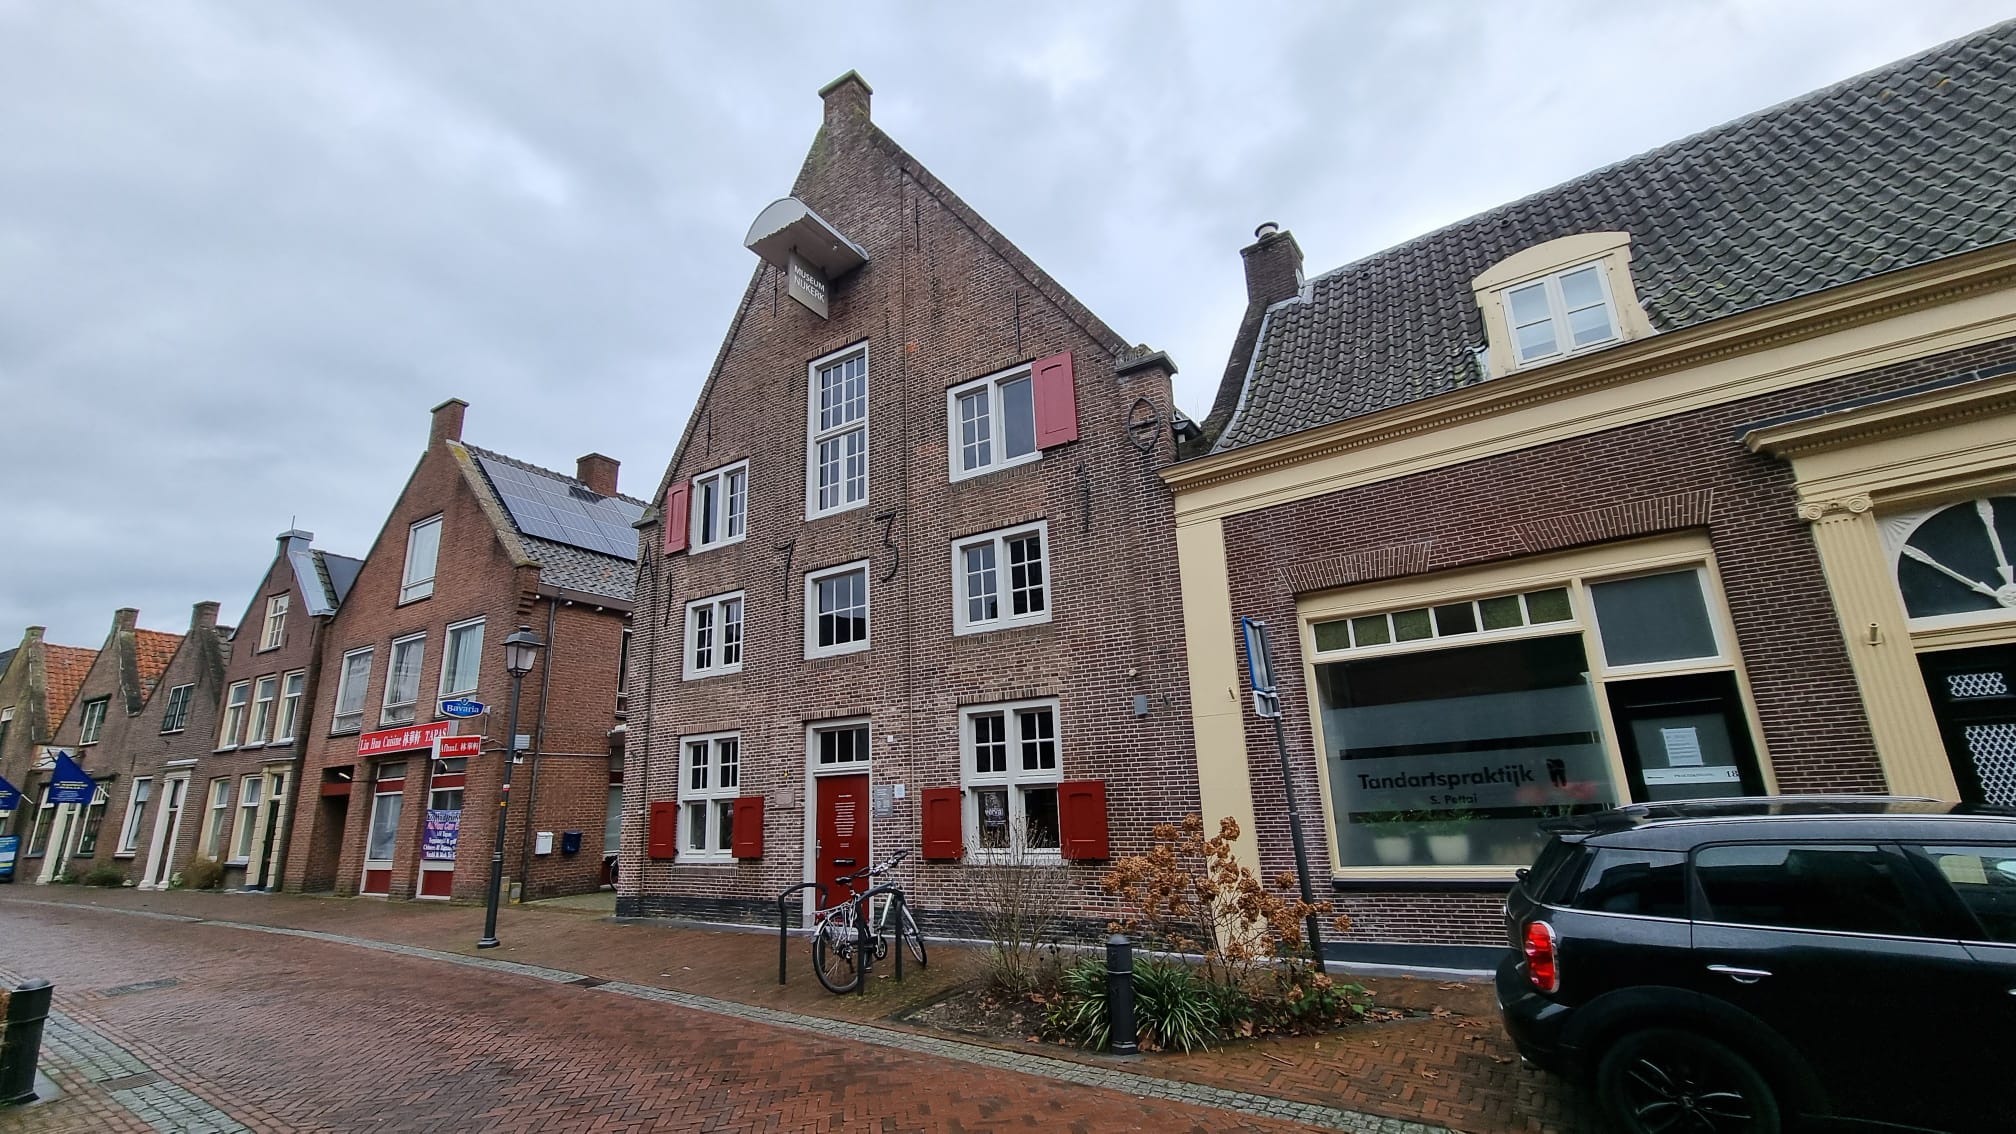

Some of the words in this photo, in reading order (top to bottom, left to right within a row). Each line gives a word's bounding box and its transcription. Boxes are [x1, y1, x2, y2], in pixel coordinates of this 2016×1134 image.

[794, 264, 825, 293] MUSEUM
[447, 704, 479, 713] Bavaria
[382, 735, 402, 748] Cuisine
[424, 728, 448, 743] TAPAS
[1358, 764, 1535, 791] Tandartspraktijk
[1726, 770, 1739, 778] 18
[1430, 795, 1441, 805] S.
